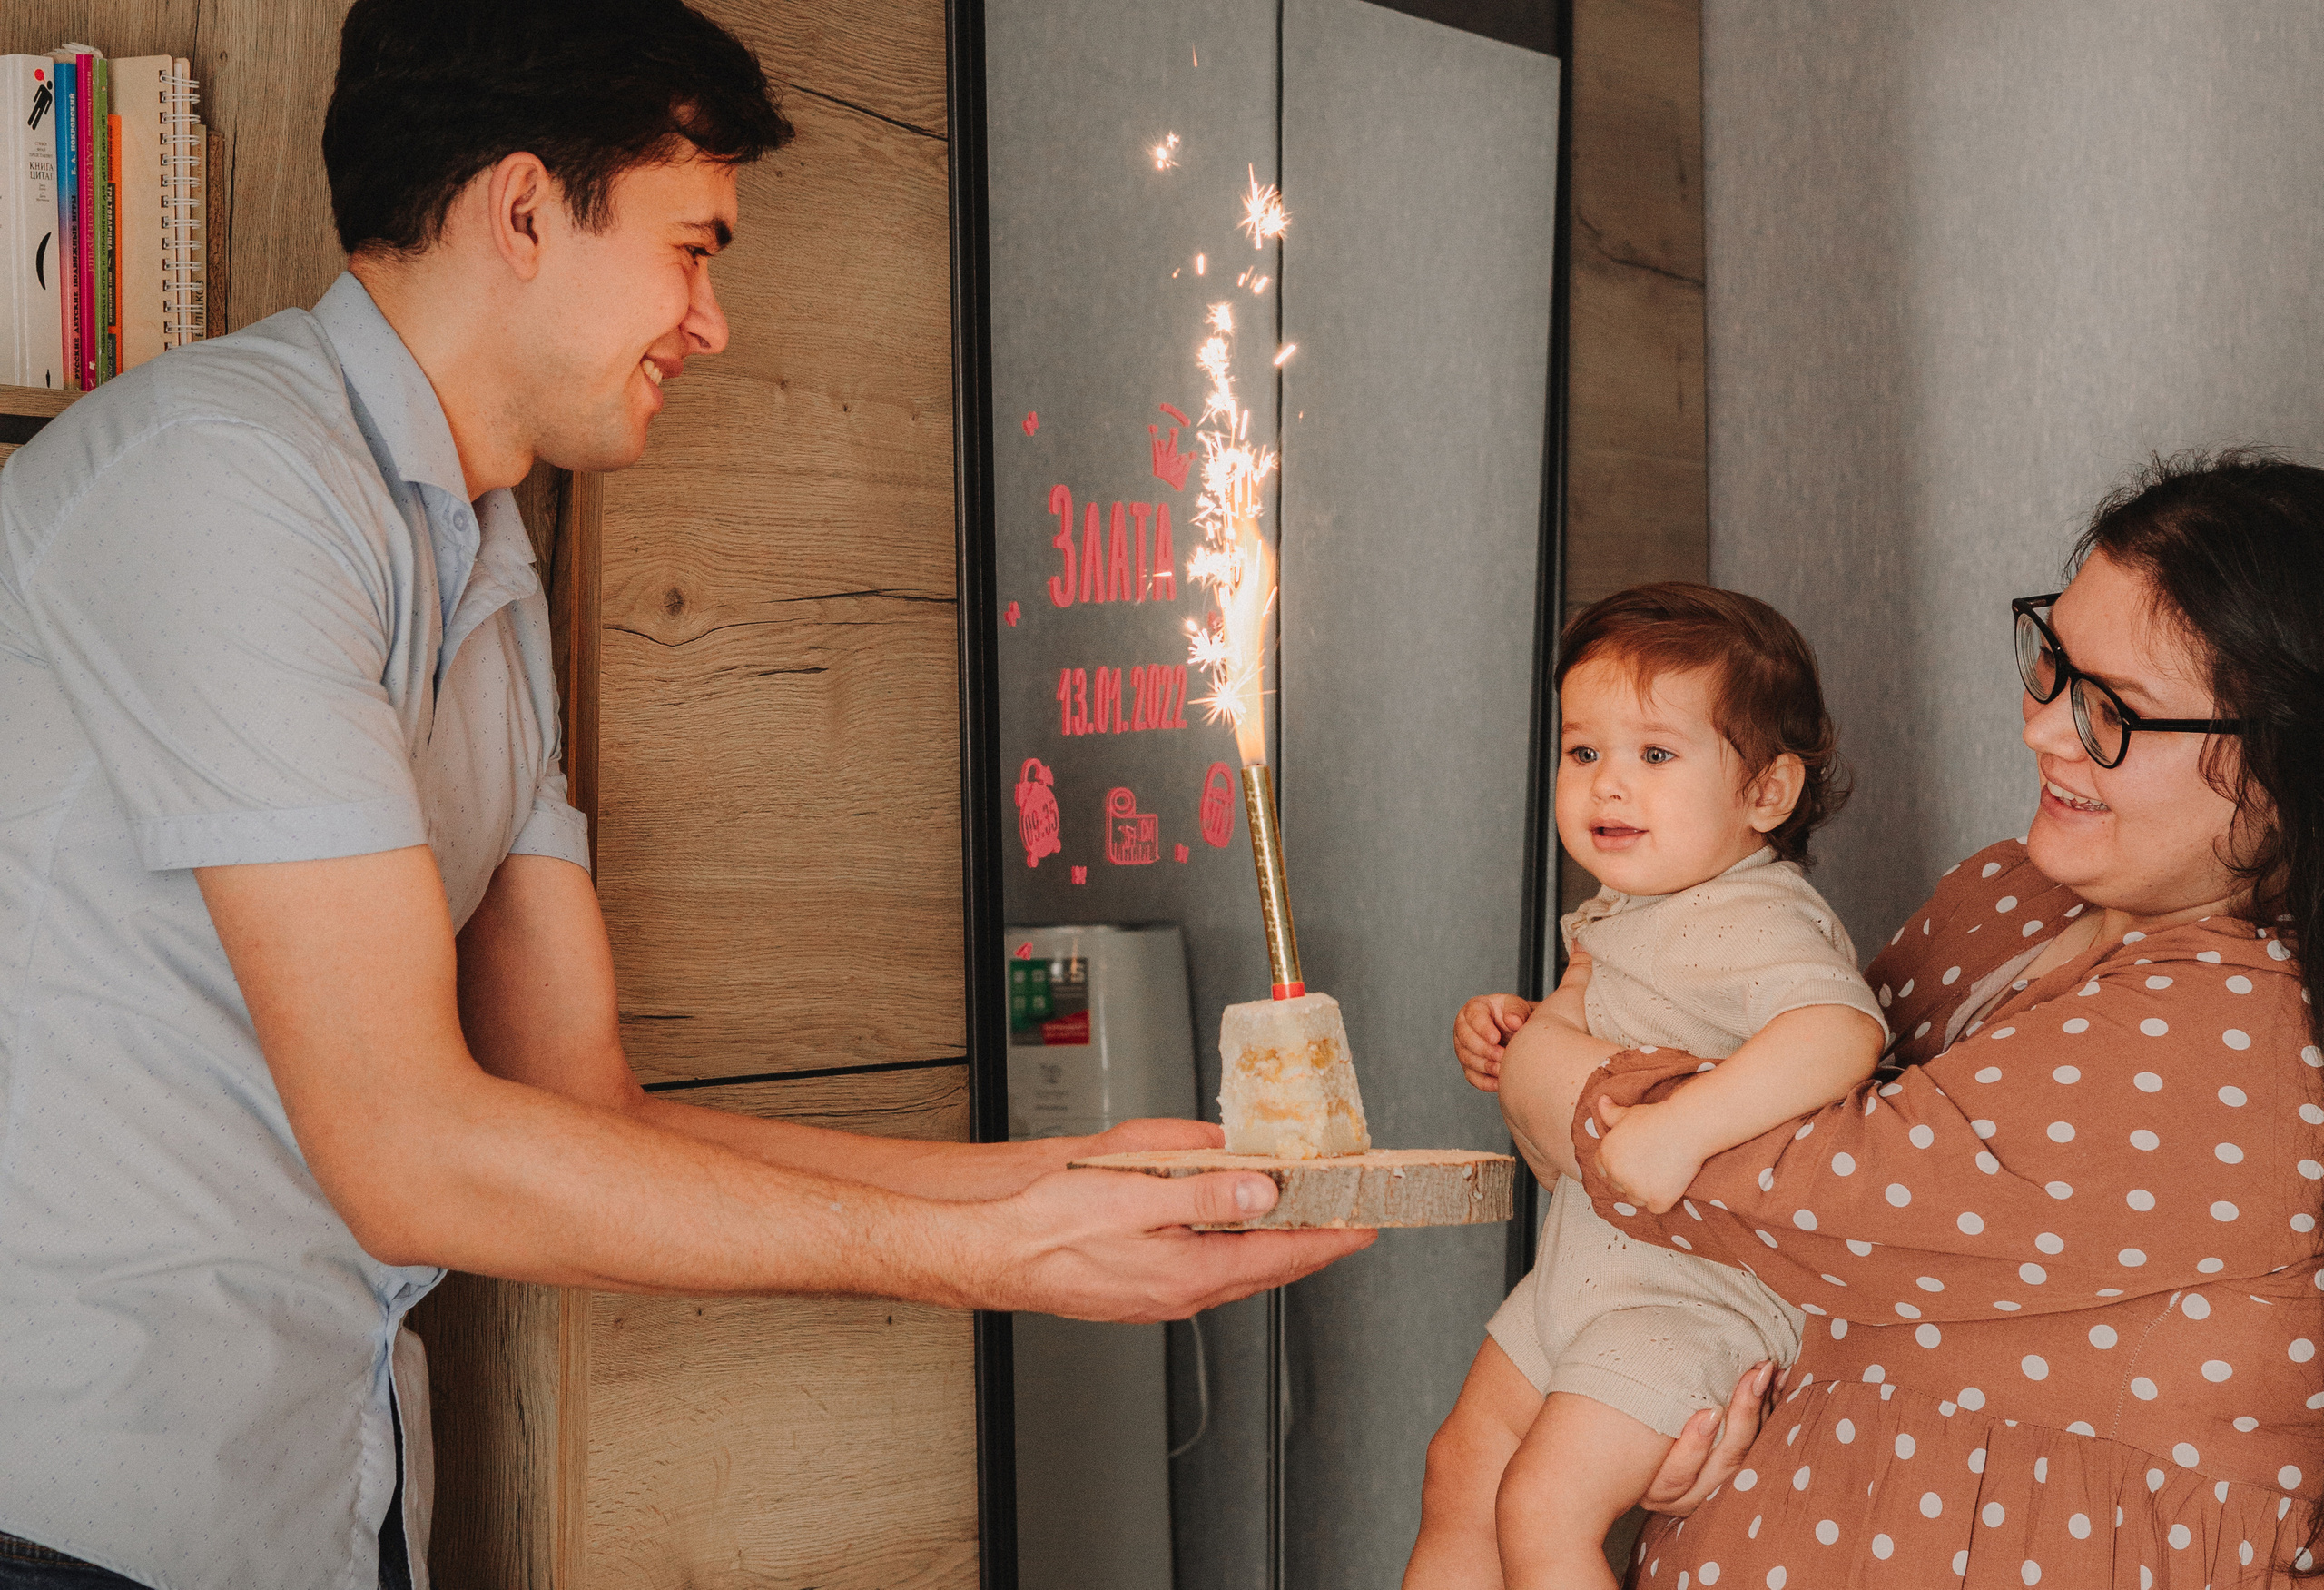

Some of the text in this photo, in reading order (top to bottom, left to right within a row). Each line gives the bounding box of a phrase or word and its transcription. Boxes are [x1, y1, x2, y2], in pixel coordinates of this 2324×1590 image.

[29, 162, 54, 171] КНИГА
[30, 171, 54, 181] ЦИТАТ
[1056, 664, 1187, 736] 13.01.2022
[1025, 800, 1058, 845] 09:35
